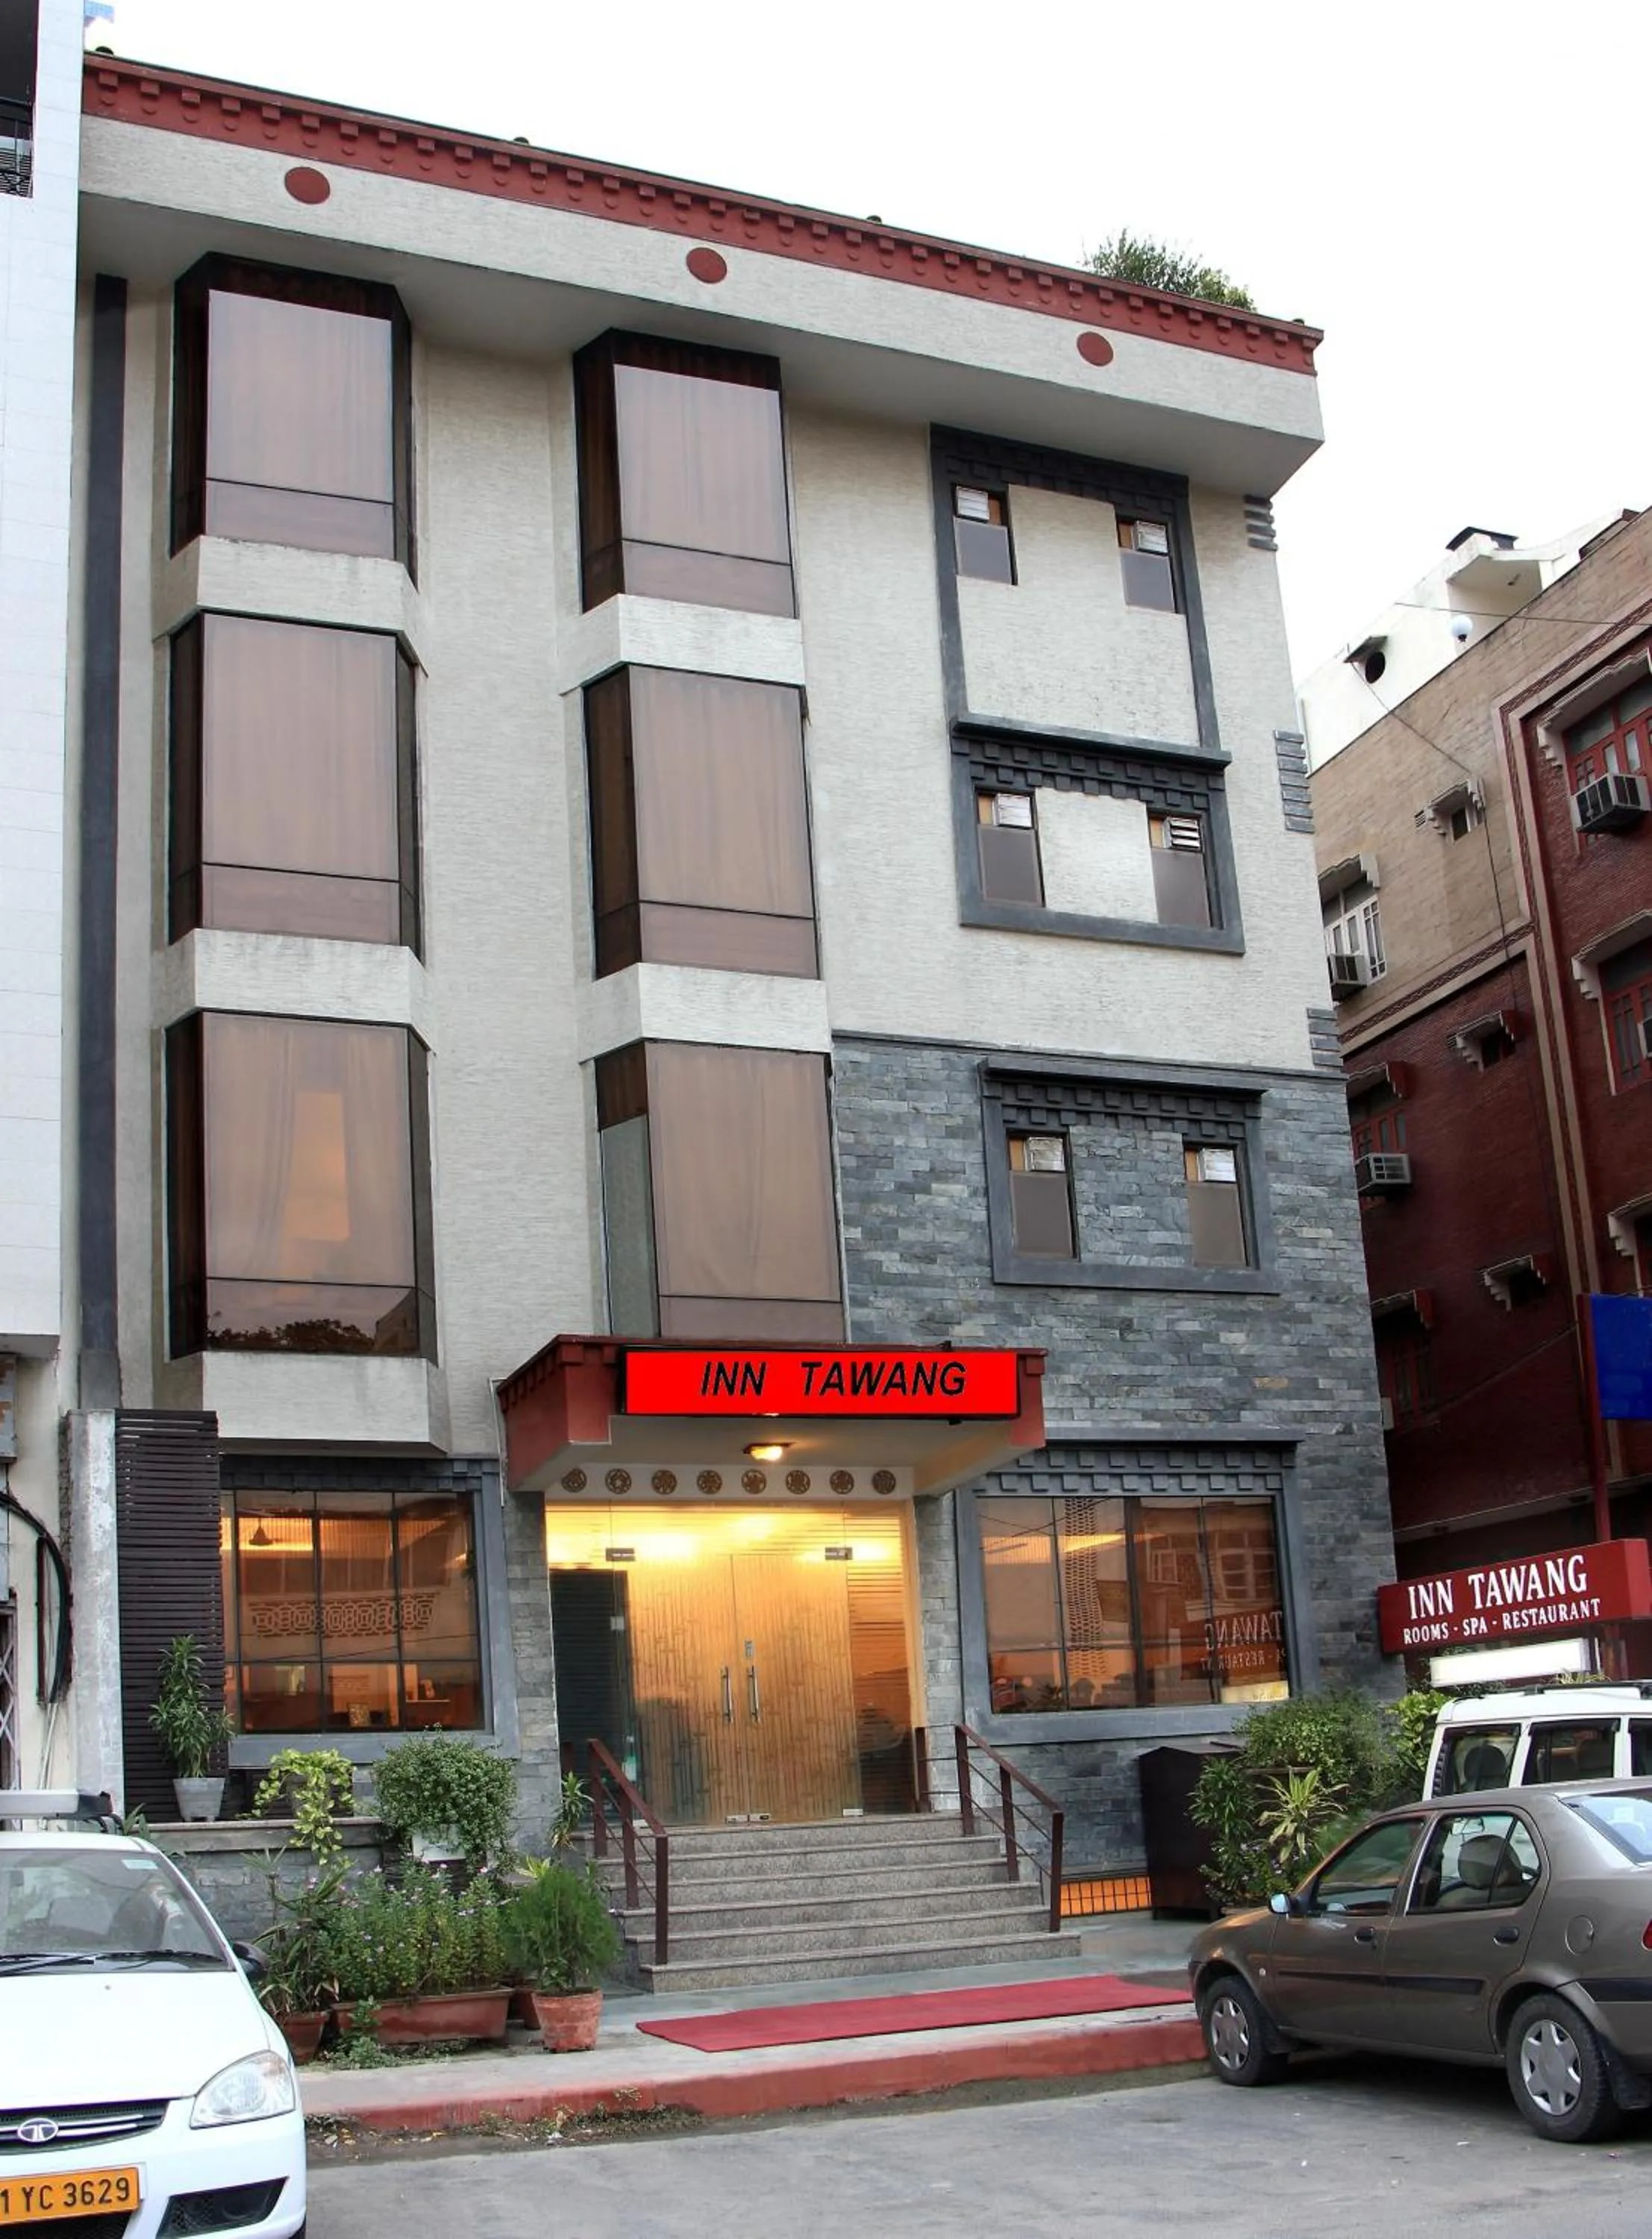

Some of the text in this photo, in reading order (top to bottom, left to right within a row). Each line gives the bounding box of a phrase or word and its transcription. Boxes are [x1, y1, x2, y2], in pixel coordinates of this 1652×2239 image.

[701, 1361, 967, 1396] INN TAWANG
[1408, 1555, 1587, 1620] INN TAWANG
[1403, 1621, 1449, 1645] ROOMS
[1462, 1617, 1489, 1637] SPA
[1502, 1599, 1601, 1630] RESTAURANT
[22, 2185, 54, 2212] YC
[63, 2177, 130, 2207] 3629
